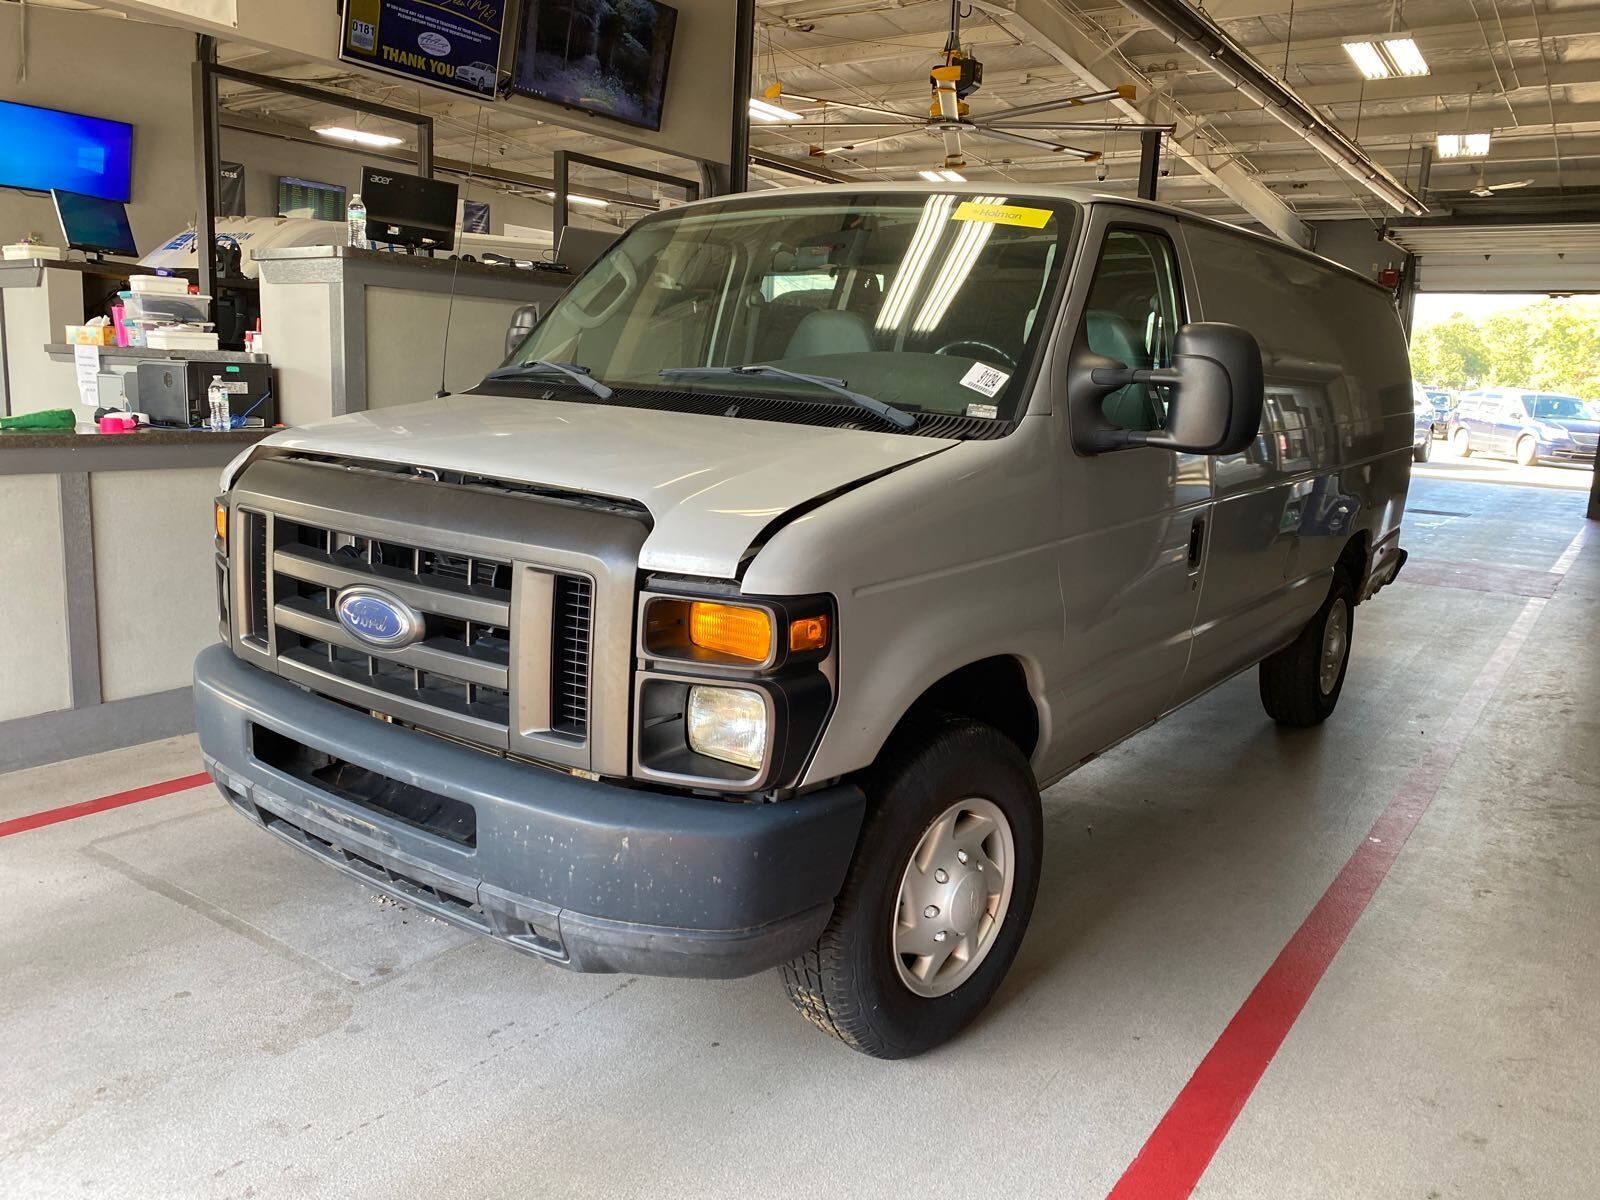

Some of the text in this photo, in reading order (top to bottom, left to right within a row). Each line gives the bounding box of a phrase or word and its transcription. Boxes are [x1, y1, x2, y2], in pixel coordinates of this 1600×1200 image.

[352, 21, 375, 36] 0181
[383, 45, 426, 70] THANK
[430, 59, 455, 77] YOU
[221, 170, 238, 179] cess
[370, 174, 393, 185] acer
[979, 208, 1023, 220] Holman
[343, 601, 389, 632] Ford
